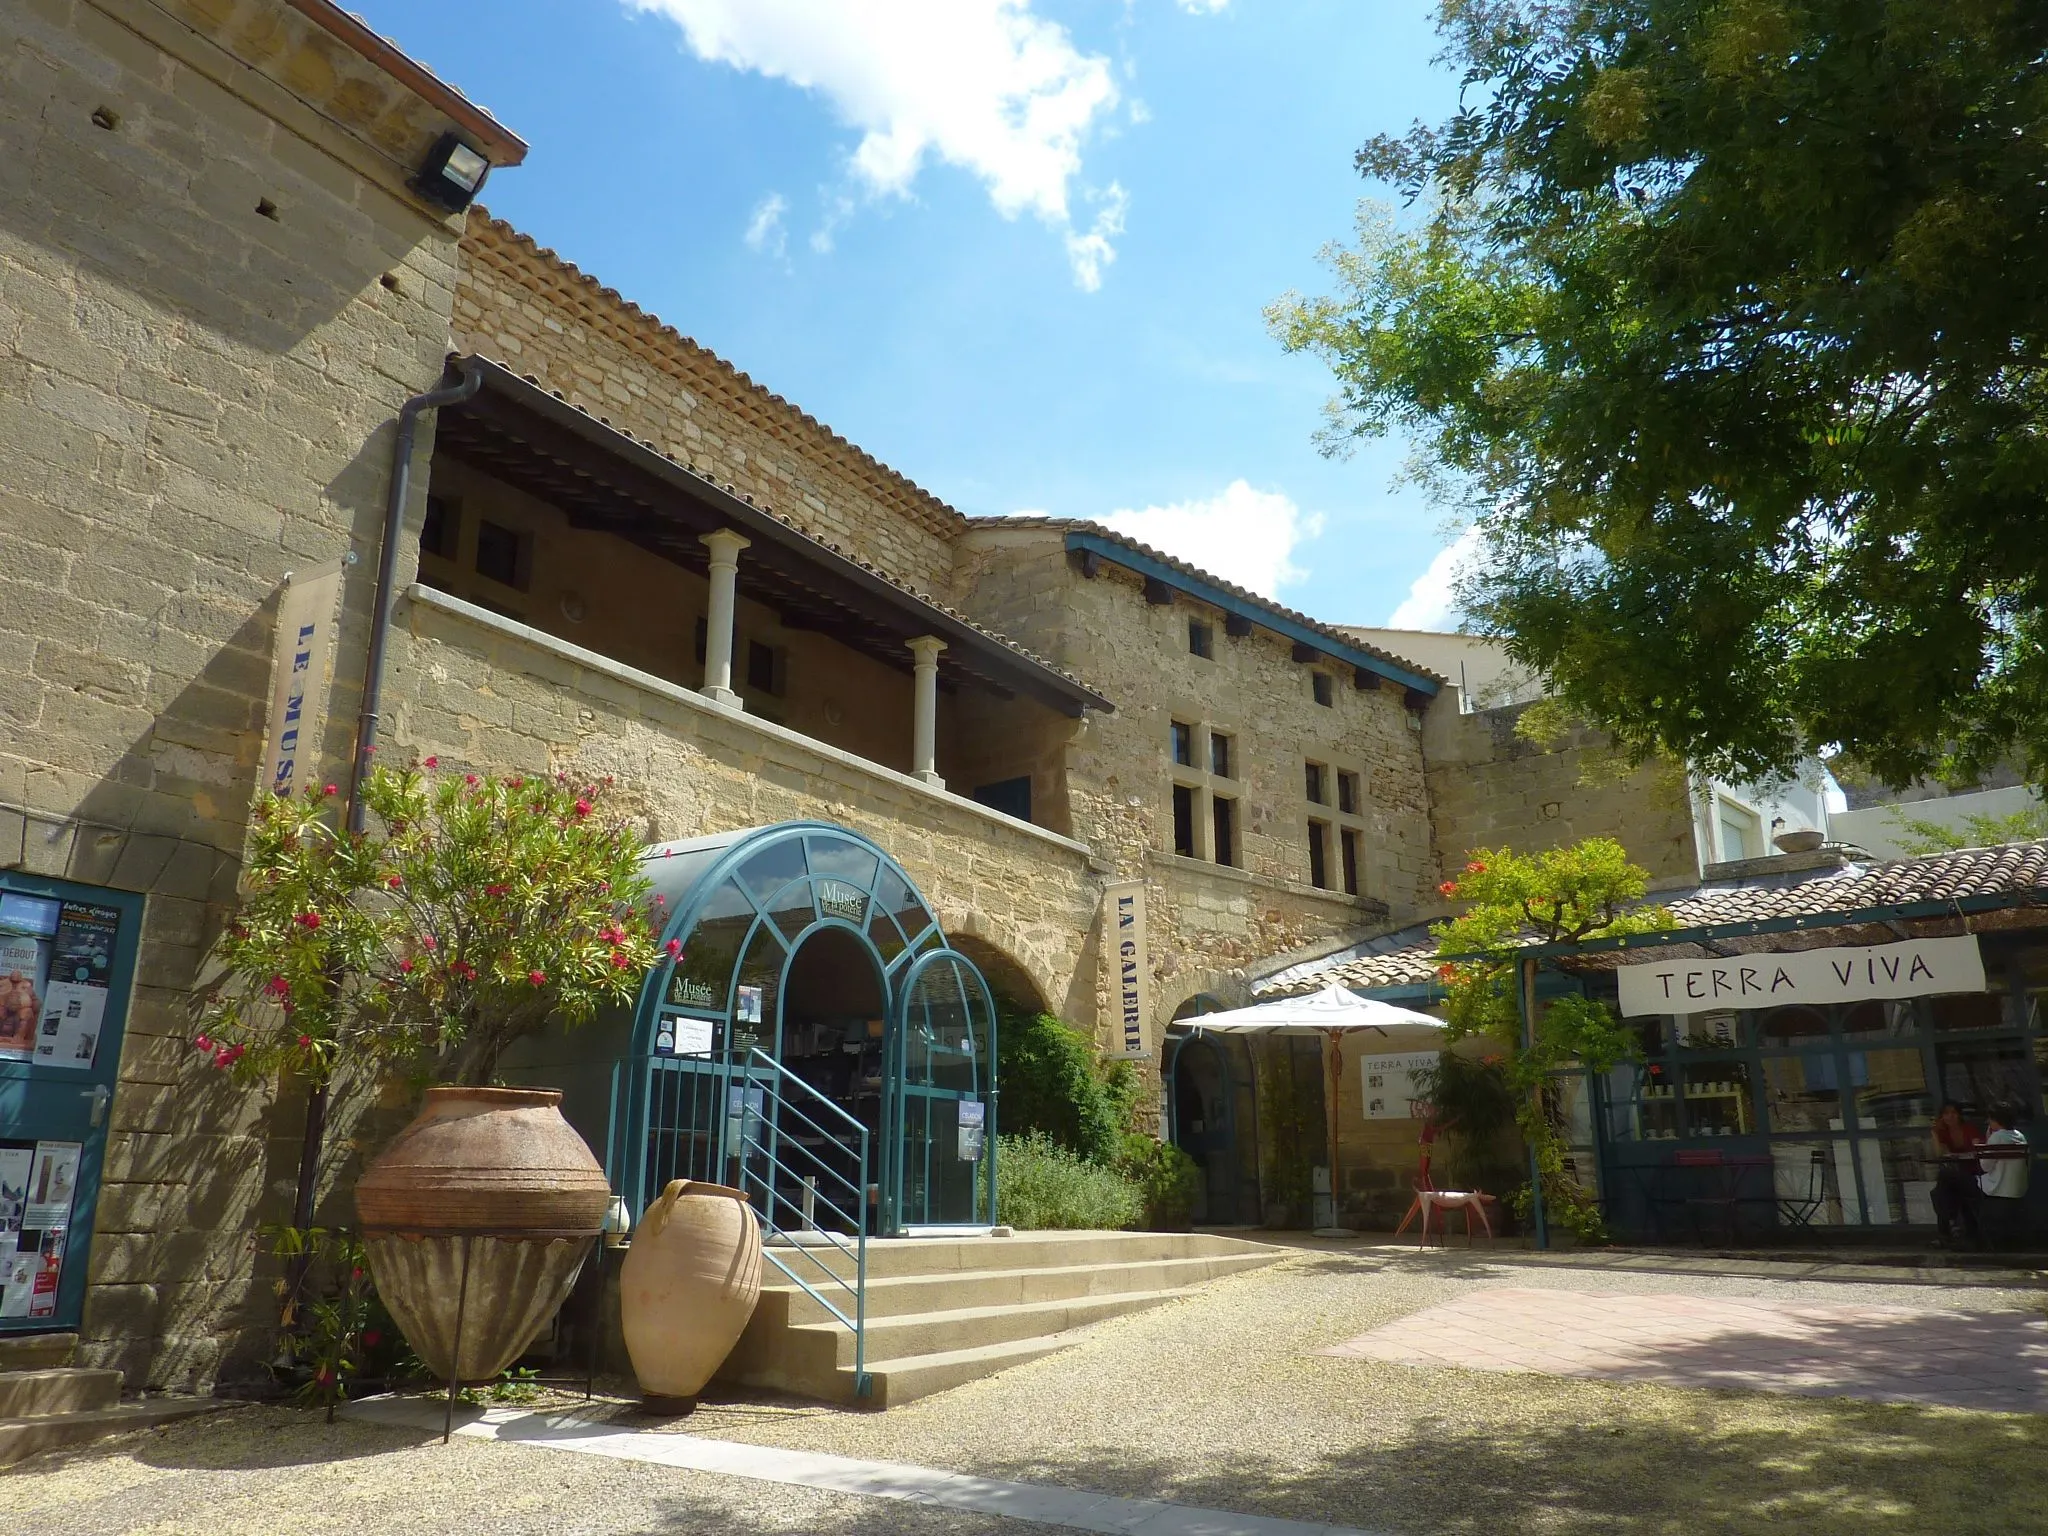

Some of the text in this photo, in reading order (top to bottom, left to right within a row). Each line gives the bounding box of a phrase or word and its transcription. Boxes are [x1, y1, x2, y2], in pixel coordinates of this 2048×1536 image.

[293, 624, 315, 673] LE
[822, 882, 862, 909] Musée
[3, 947, 37, 959] DEBOUT
[674, 976, 712, 996] Musée
[1118, 896, 1141, 1051] LA GALERIE
[1656, 966, 1796, 999] TERRA
[1367, 1060, 1402, 1070] TERRA
